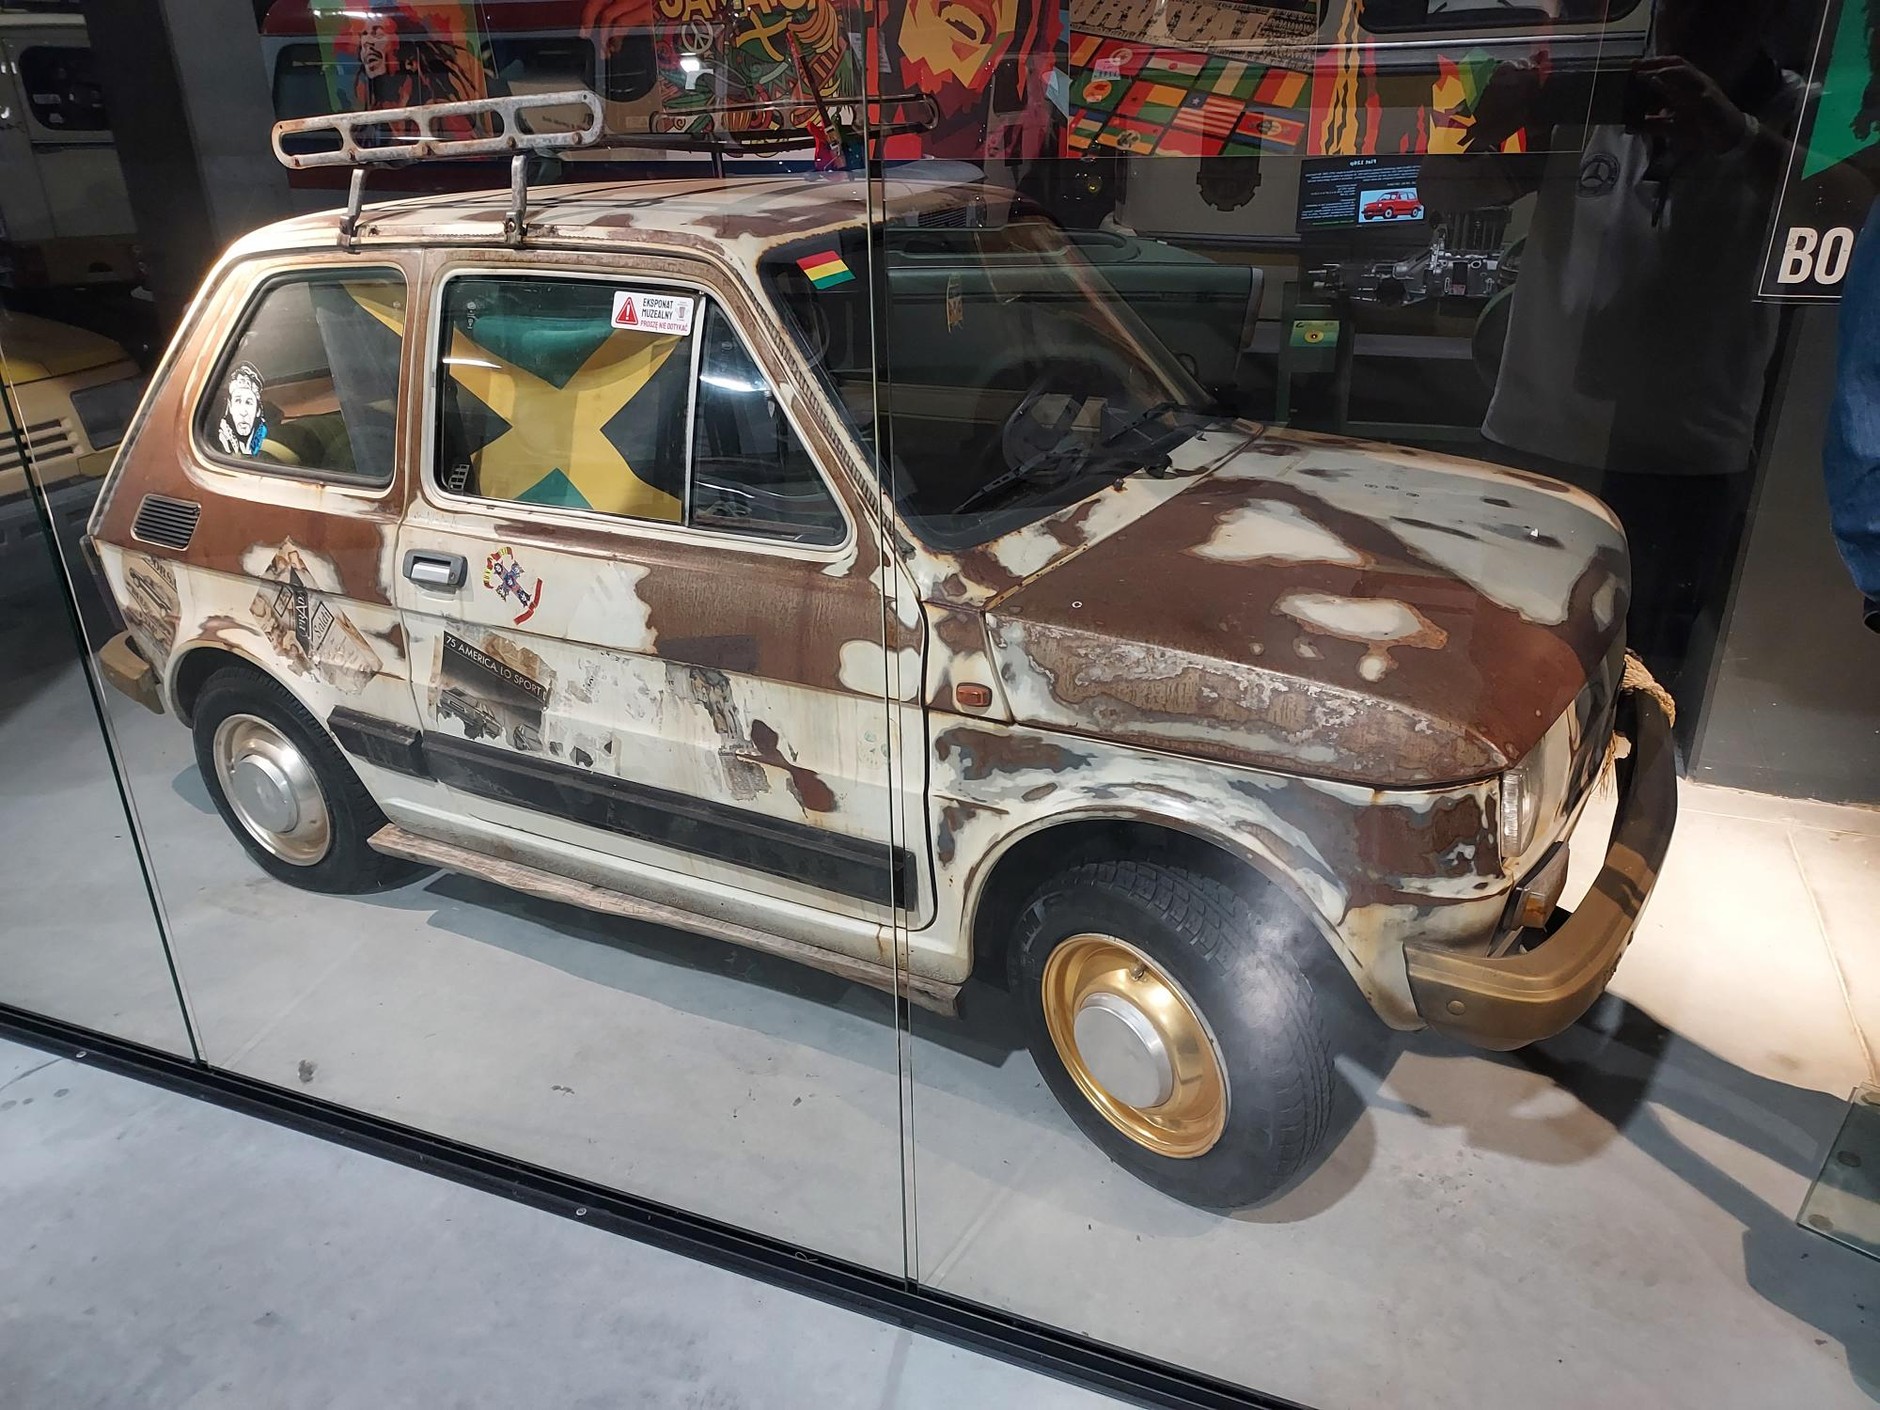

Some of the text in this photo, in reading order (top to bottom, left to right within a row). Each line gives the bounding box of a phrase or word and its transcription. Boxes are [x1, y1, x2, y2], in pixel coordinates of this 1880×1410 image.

[643, 298, 674, 309] EKSPONAT
[641, 309, 673, 320] MUZEALNY
[445, 635, 456, 648] 75
[500, 667, 512, 679] LO
[513, 674, 541, 697] SPORT
